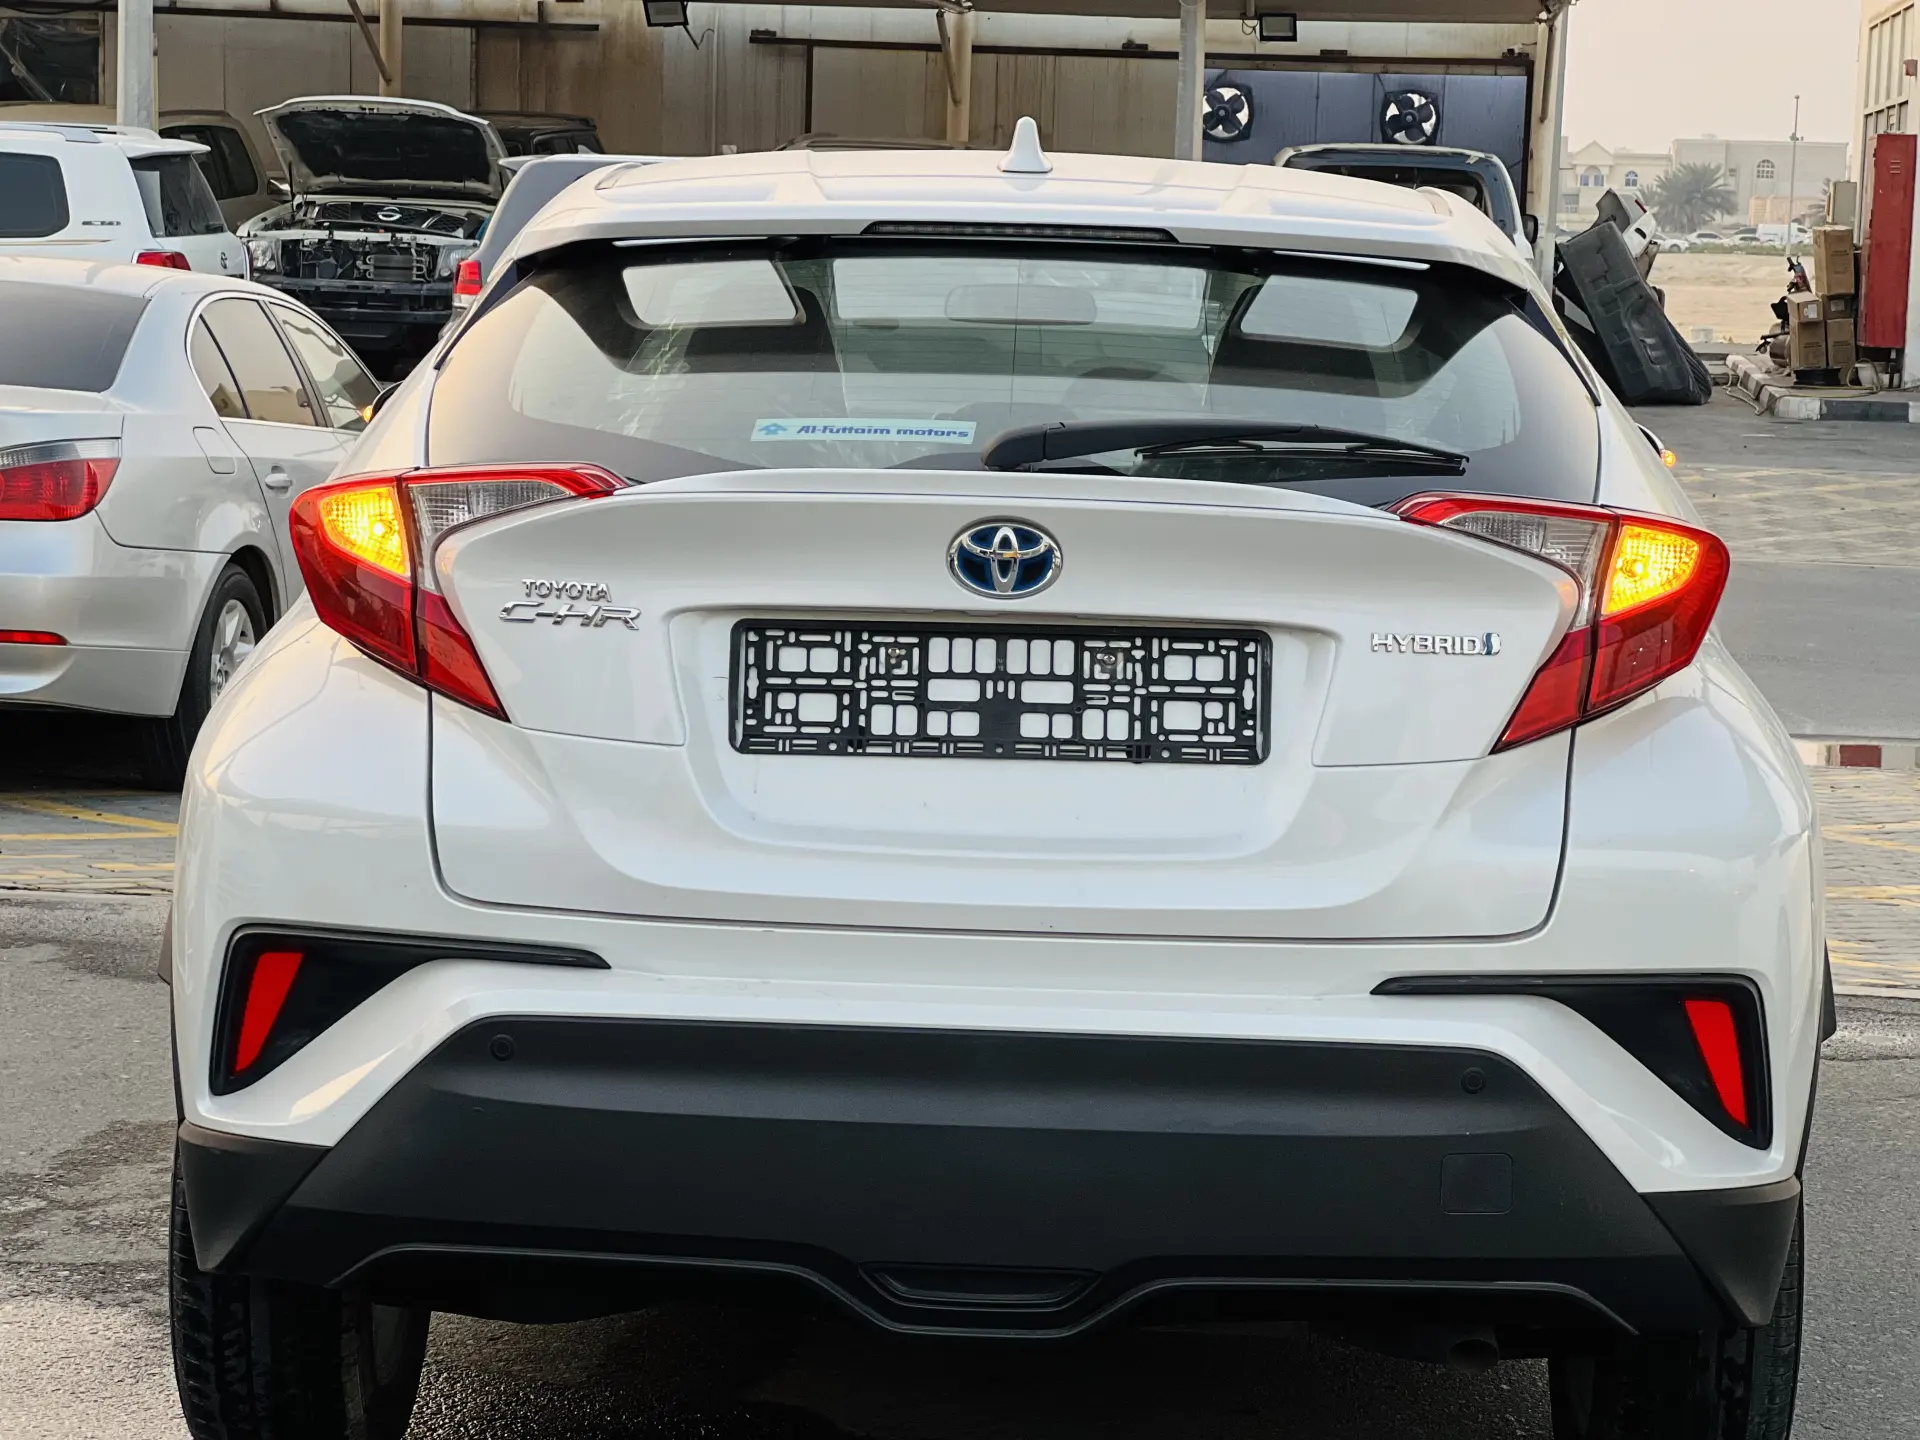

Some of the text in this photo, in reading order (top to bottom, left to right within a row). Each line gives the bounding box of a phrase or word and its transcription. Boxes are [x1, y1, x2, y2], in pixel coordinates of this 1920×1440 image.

[796, 425, 969, 438] Al-Futtaim motors
[522, 579, 612, 602] TOYOTA
[499, 601, 642, 630] C-HR
[1371, 633, 1481, 655] HYBRID
